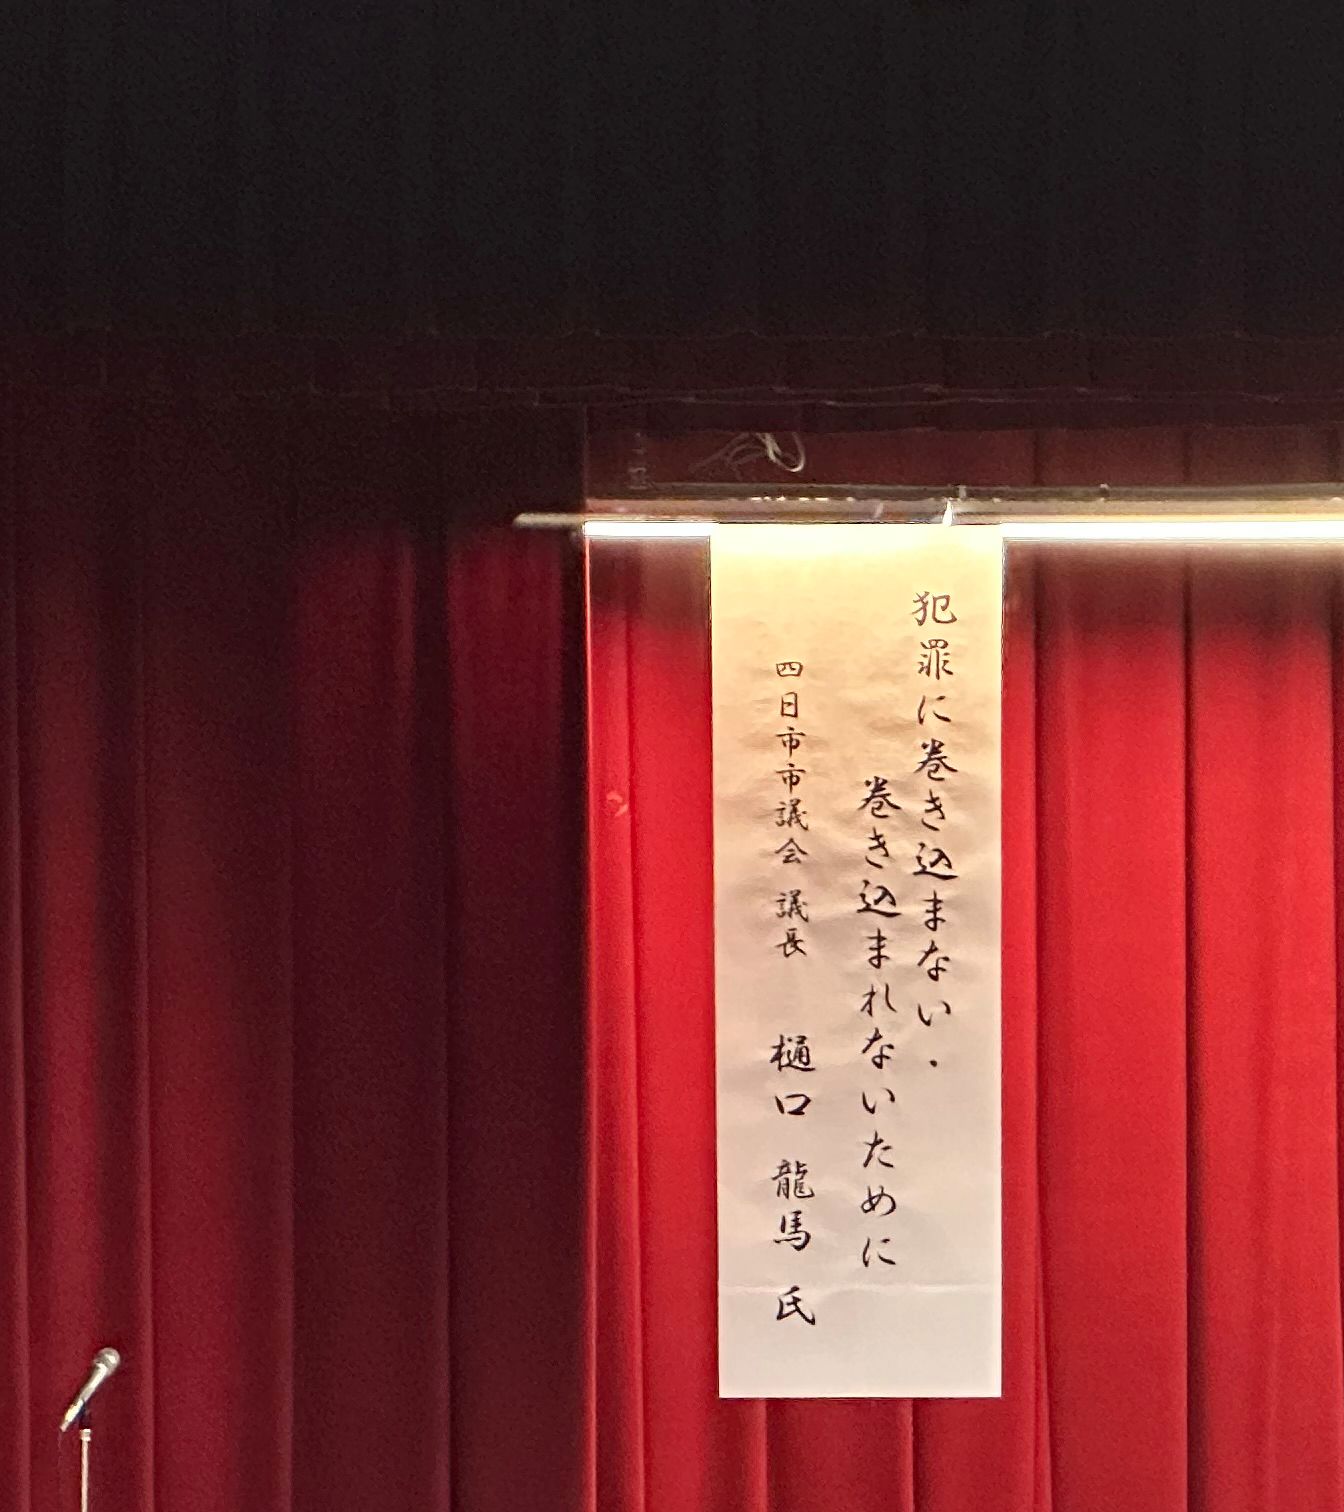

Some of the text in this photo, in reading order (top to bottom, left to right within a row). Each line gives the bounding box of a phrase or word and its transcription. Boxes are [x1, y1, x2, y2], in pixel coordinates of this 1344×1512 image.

[775, 661, 810, 959] 四日市市議会 議長
[856, 776, 902, 1268] 巻き込まれないために
[769, 1034, 817, 1327] 樋口 龍馬 氏
